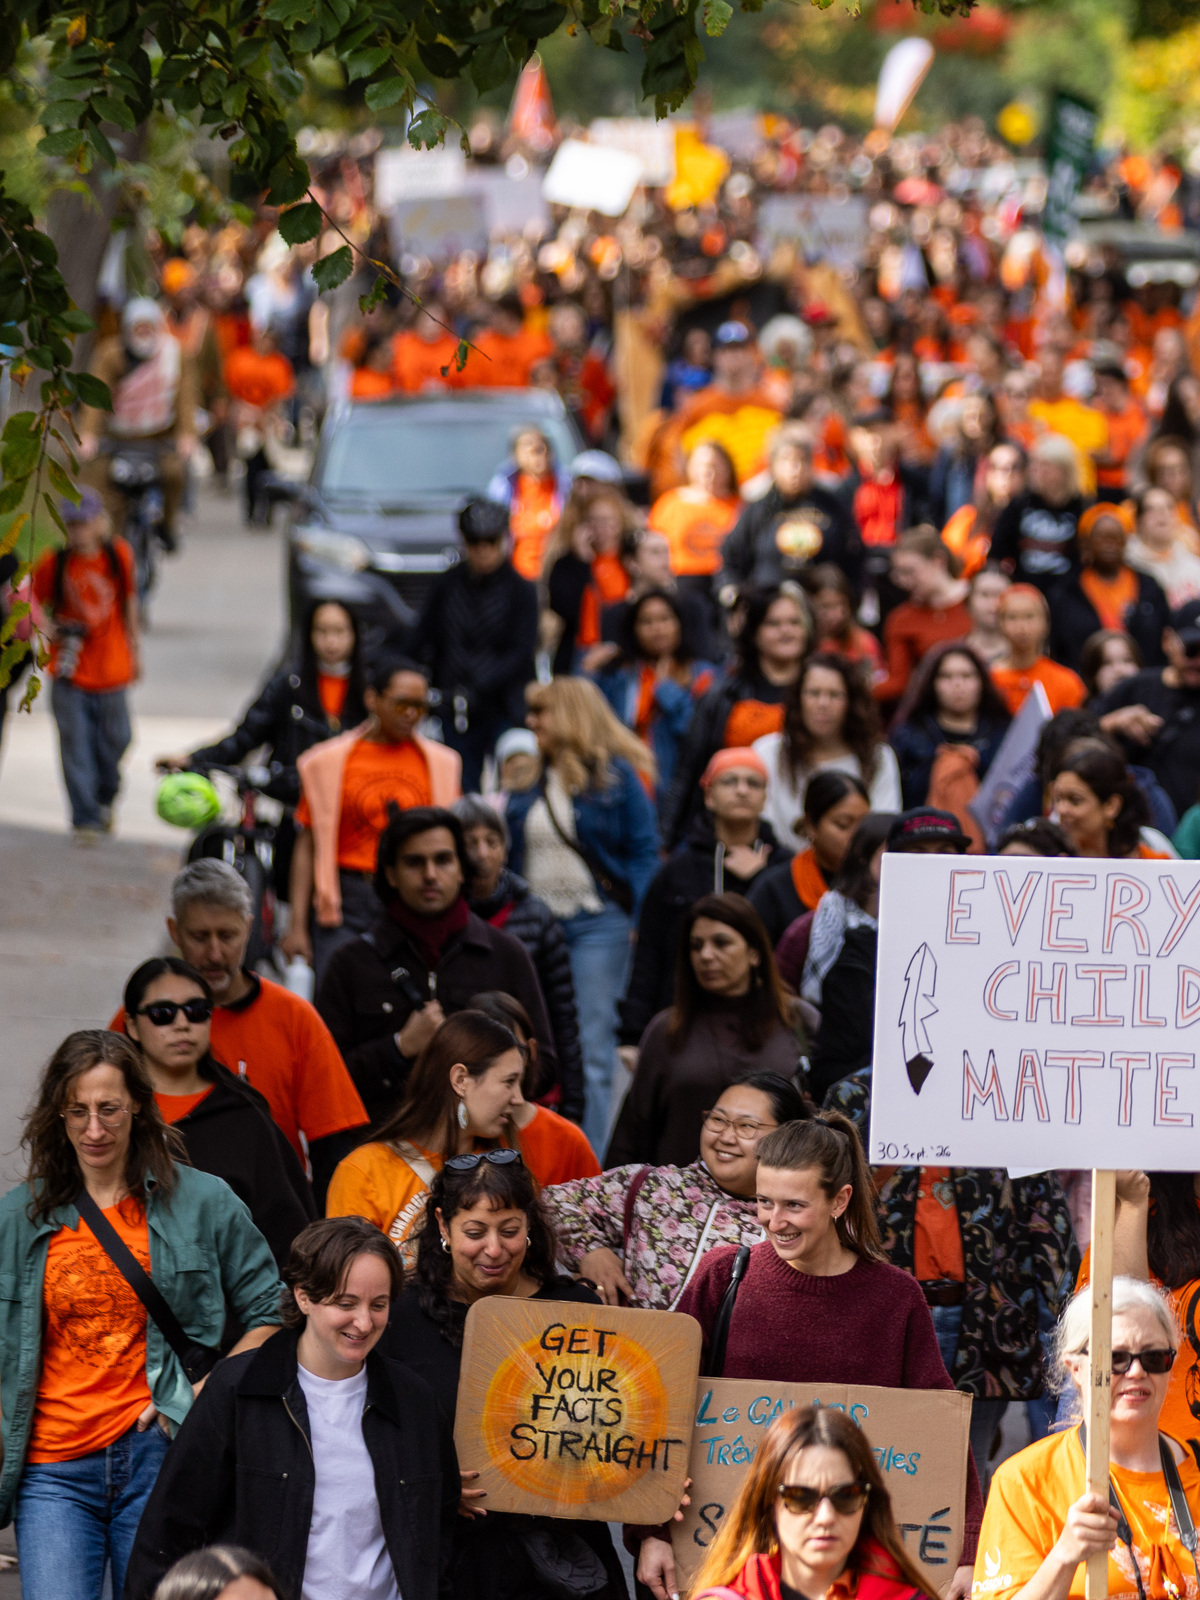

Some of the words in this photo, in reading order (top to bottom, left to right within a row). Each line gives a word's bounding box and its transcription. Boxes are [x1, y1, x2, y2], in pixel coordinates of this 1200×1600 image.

[878, 1141, 899, 1160] 30
[540, 1322, 617, 1357] GET
[535, 1362, 619, 1393] YOUR
[531, 1394, 622, 1426] FACTS
[696, 1390, 740, 1427] Le
[510, 1424, 683, 1471] STRAIGHT
